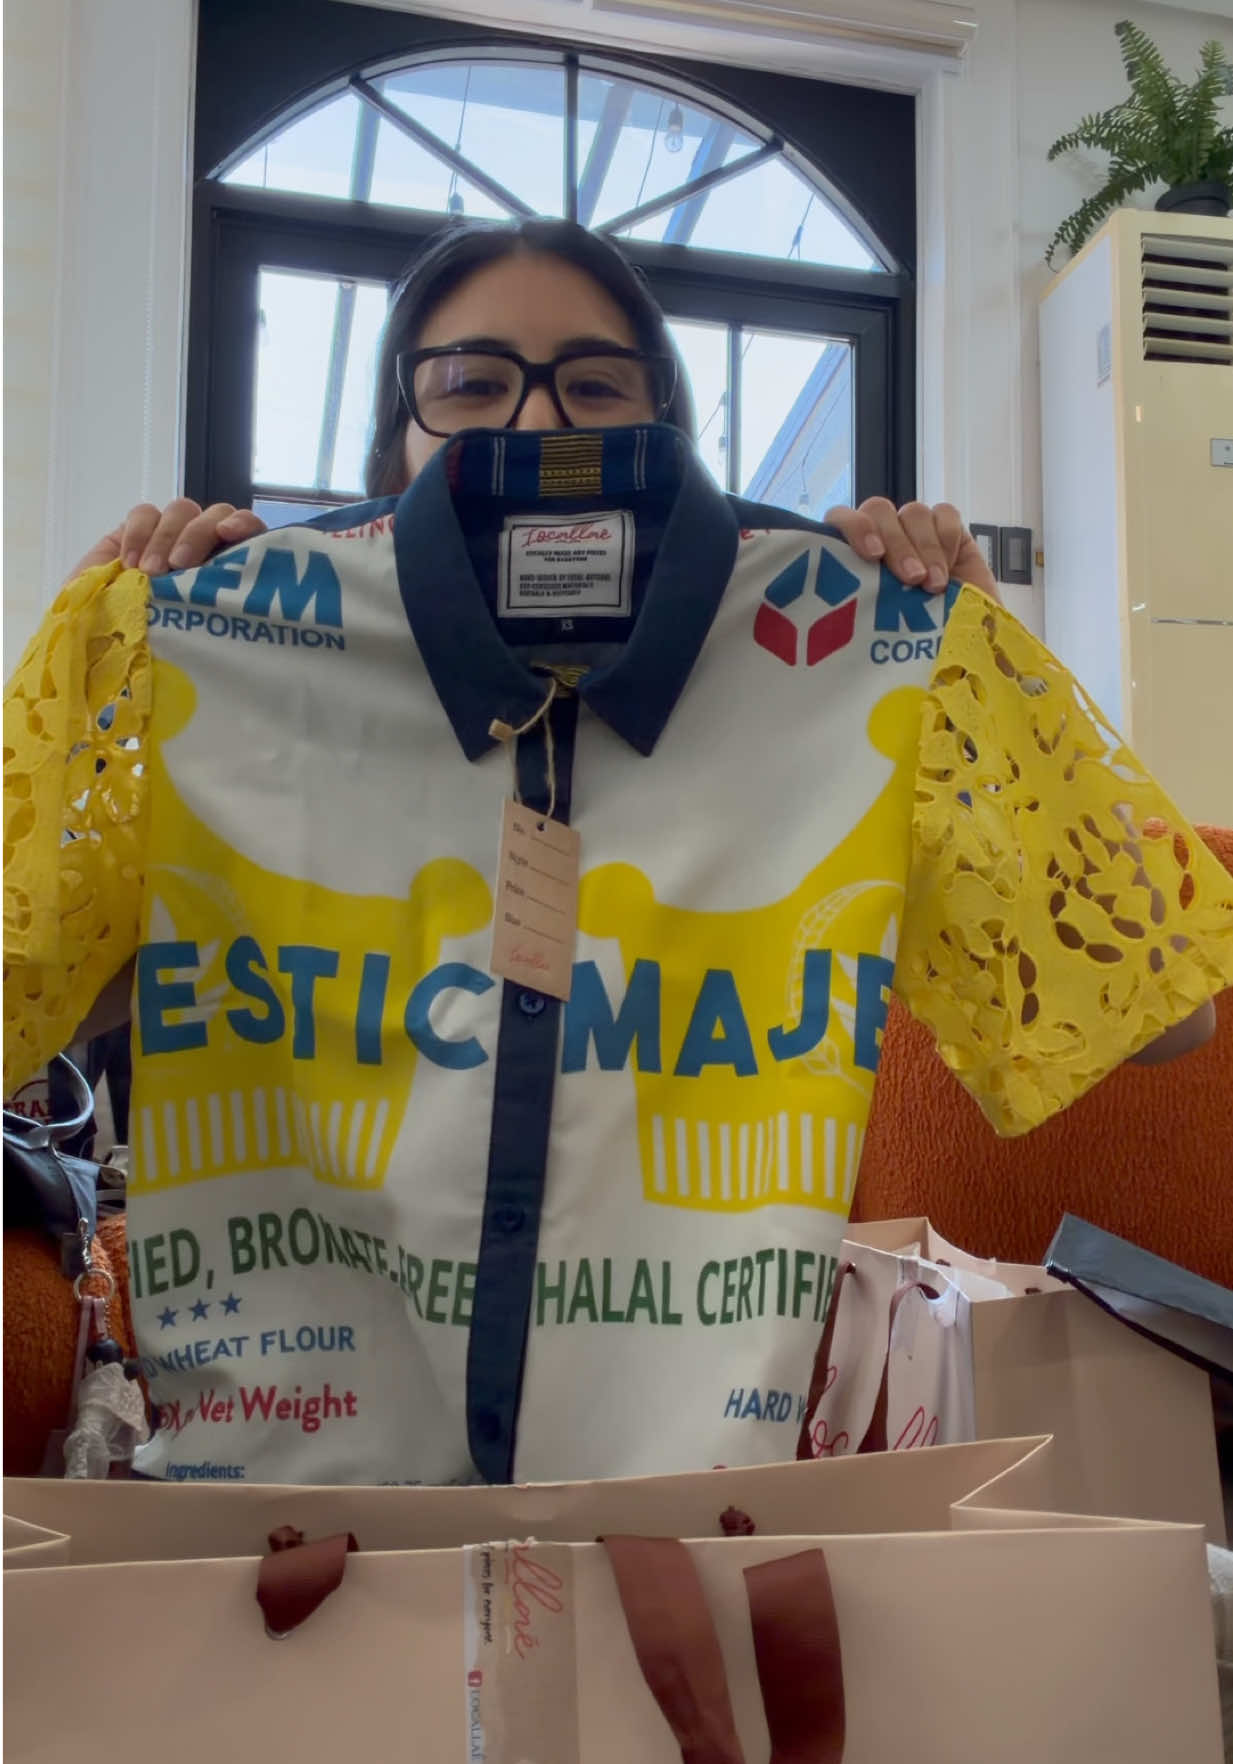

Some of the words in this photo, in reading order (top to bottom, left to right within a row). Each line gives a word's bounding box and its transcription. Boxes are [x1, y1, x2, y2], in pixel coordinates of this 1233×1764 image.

[137, 936, 495, 1070] ESTIC
[536, 1257, 683, 1326] HALAL
[261, 1326, 356, 1355] FLOUR
[239, 1383, 357, 1433] Weight
[723, 1388, 792, 1422] HARD
